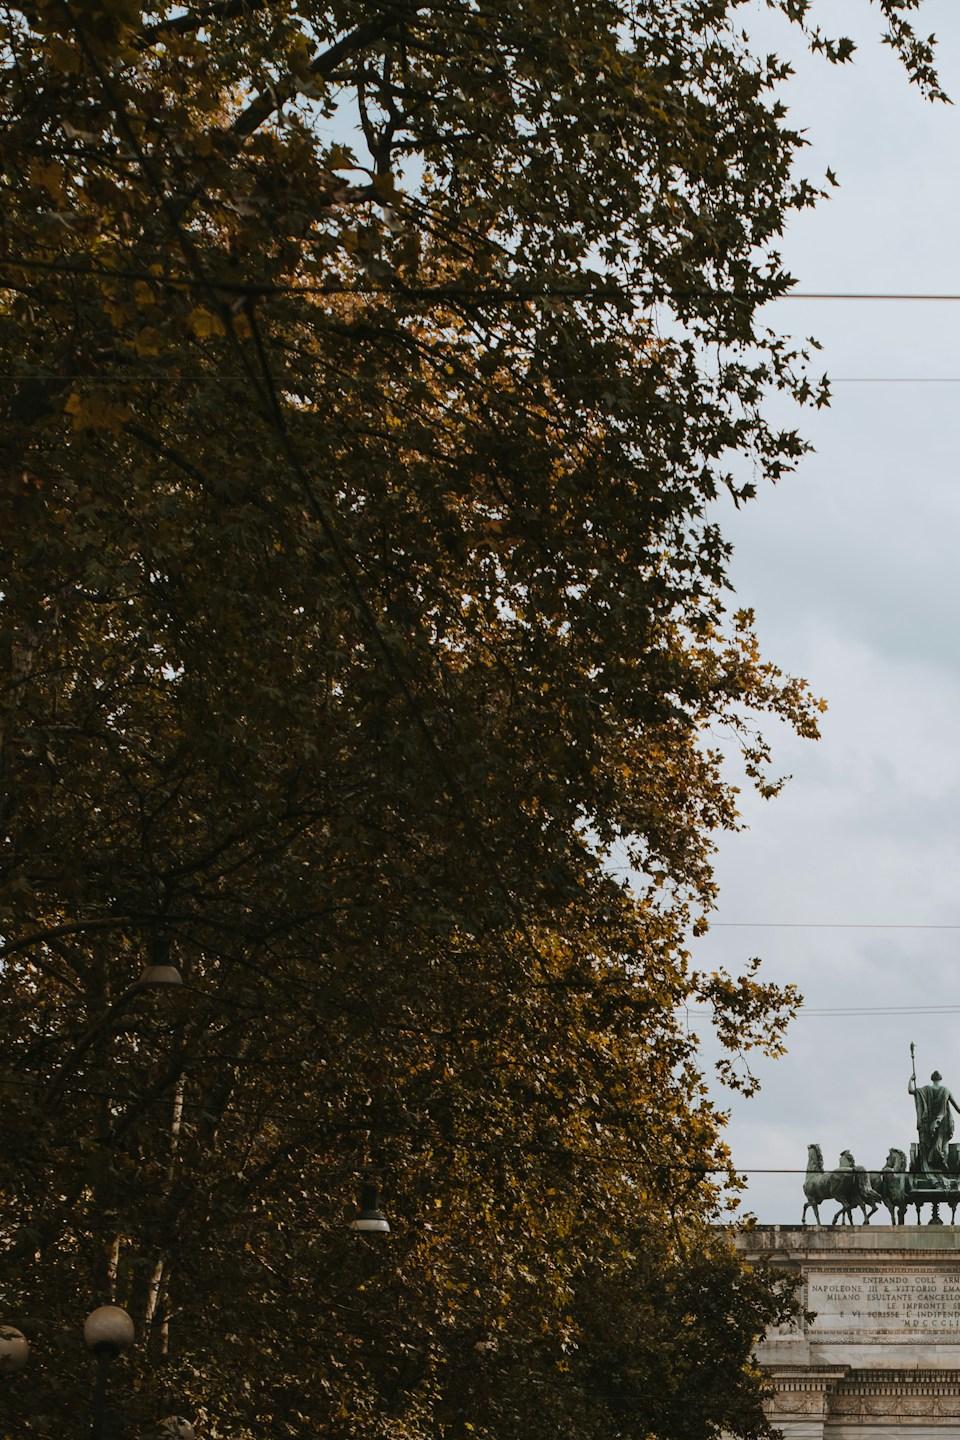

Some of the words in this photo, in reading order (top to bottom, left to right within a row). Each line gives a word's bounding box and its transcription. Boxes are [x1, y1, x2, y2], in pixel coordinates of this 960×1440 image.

[812, 1285, 862, 1293] NAPOLEONE
[869, 1285, 878, 1293] III
[896, 1285, 937, 1293] VITTORIO
[887, 1302, 897, 1310] LE
[902, 1302, 946, 1310] IMPRONTE
